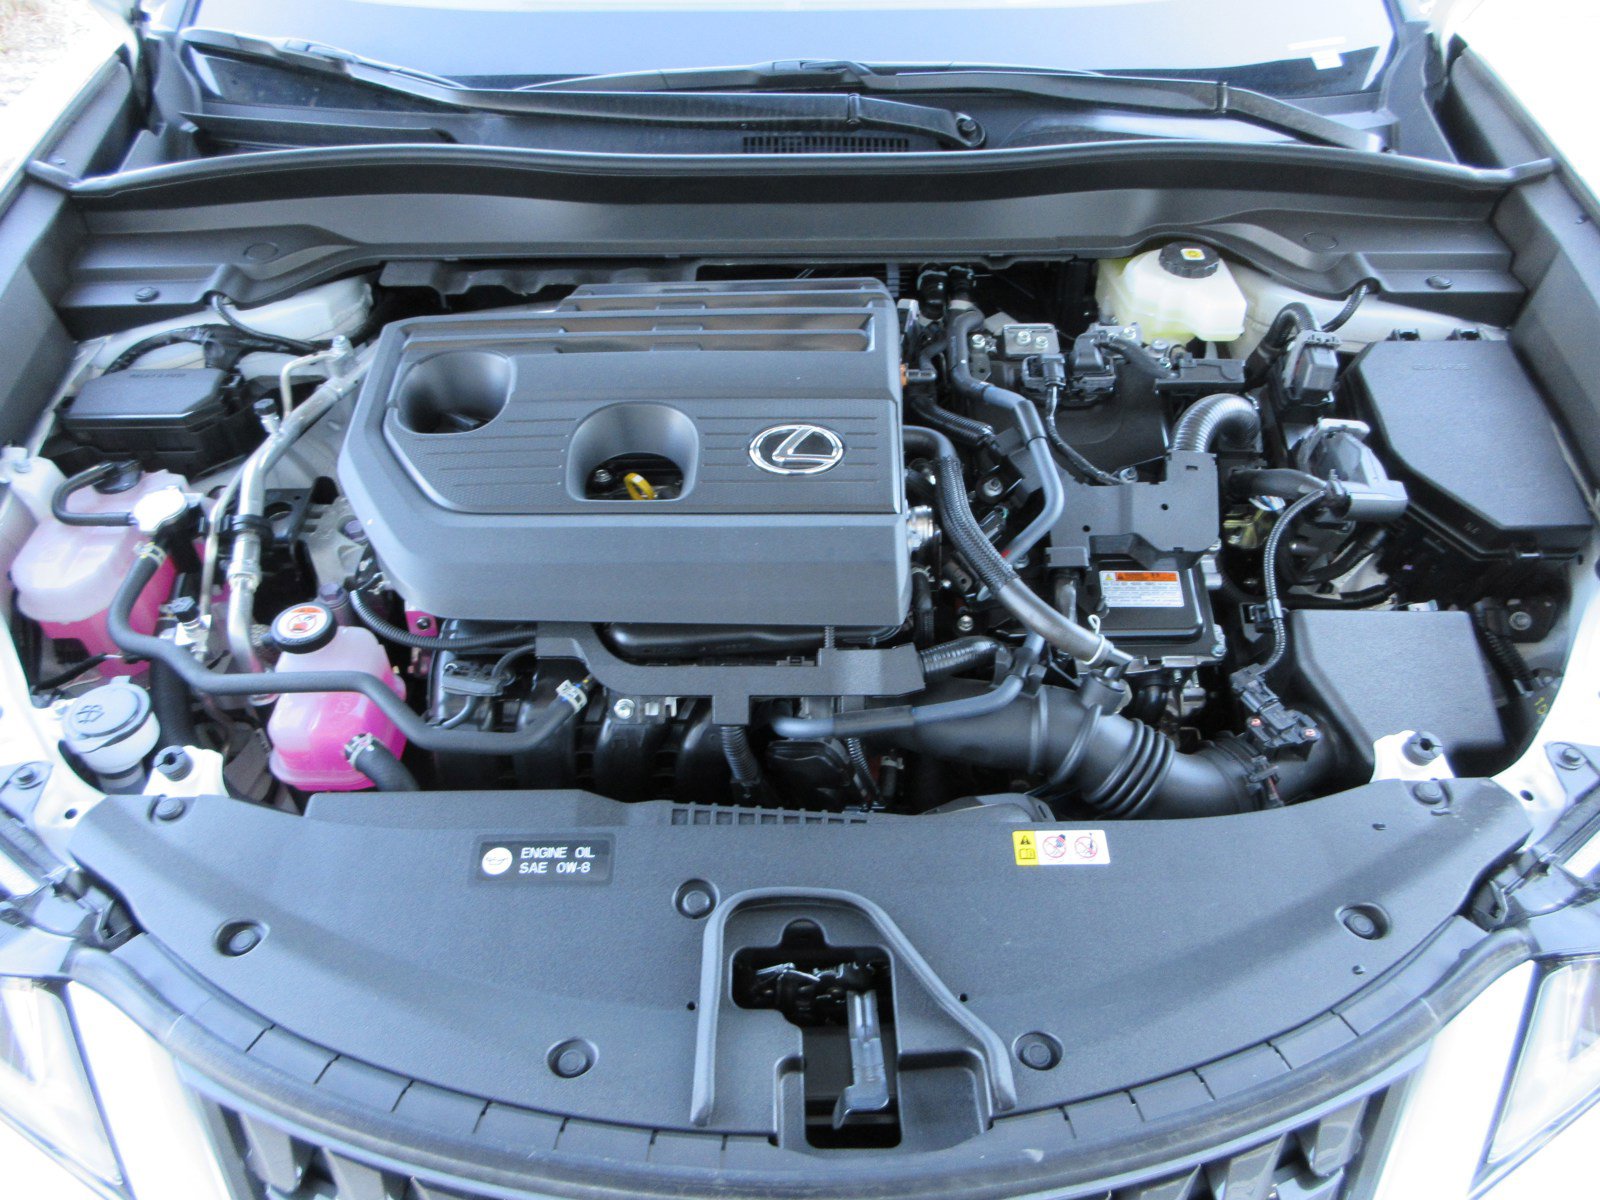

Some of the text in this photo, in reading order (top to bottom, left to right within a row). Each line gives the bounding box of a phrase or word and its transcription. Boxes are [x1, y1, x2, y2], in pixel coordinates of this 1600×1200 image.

[520, 847, 595, 859] ENGINE OIL
[519, 862, 591, 874] SAE 0W-8
